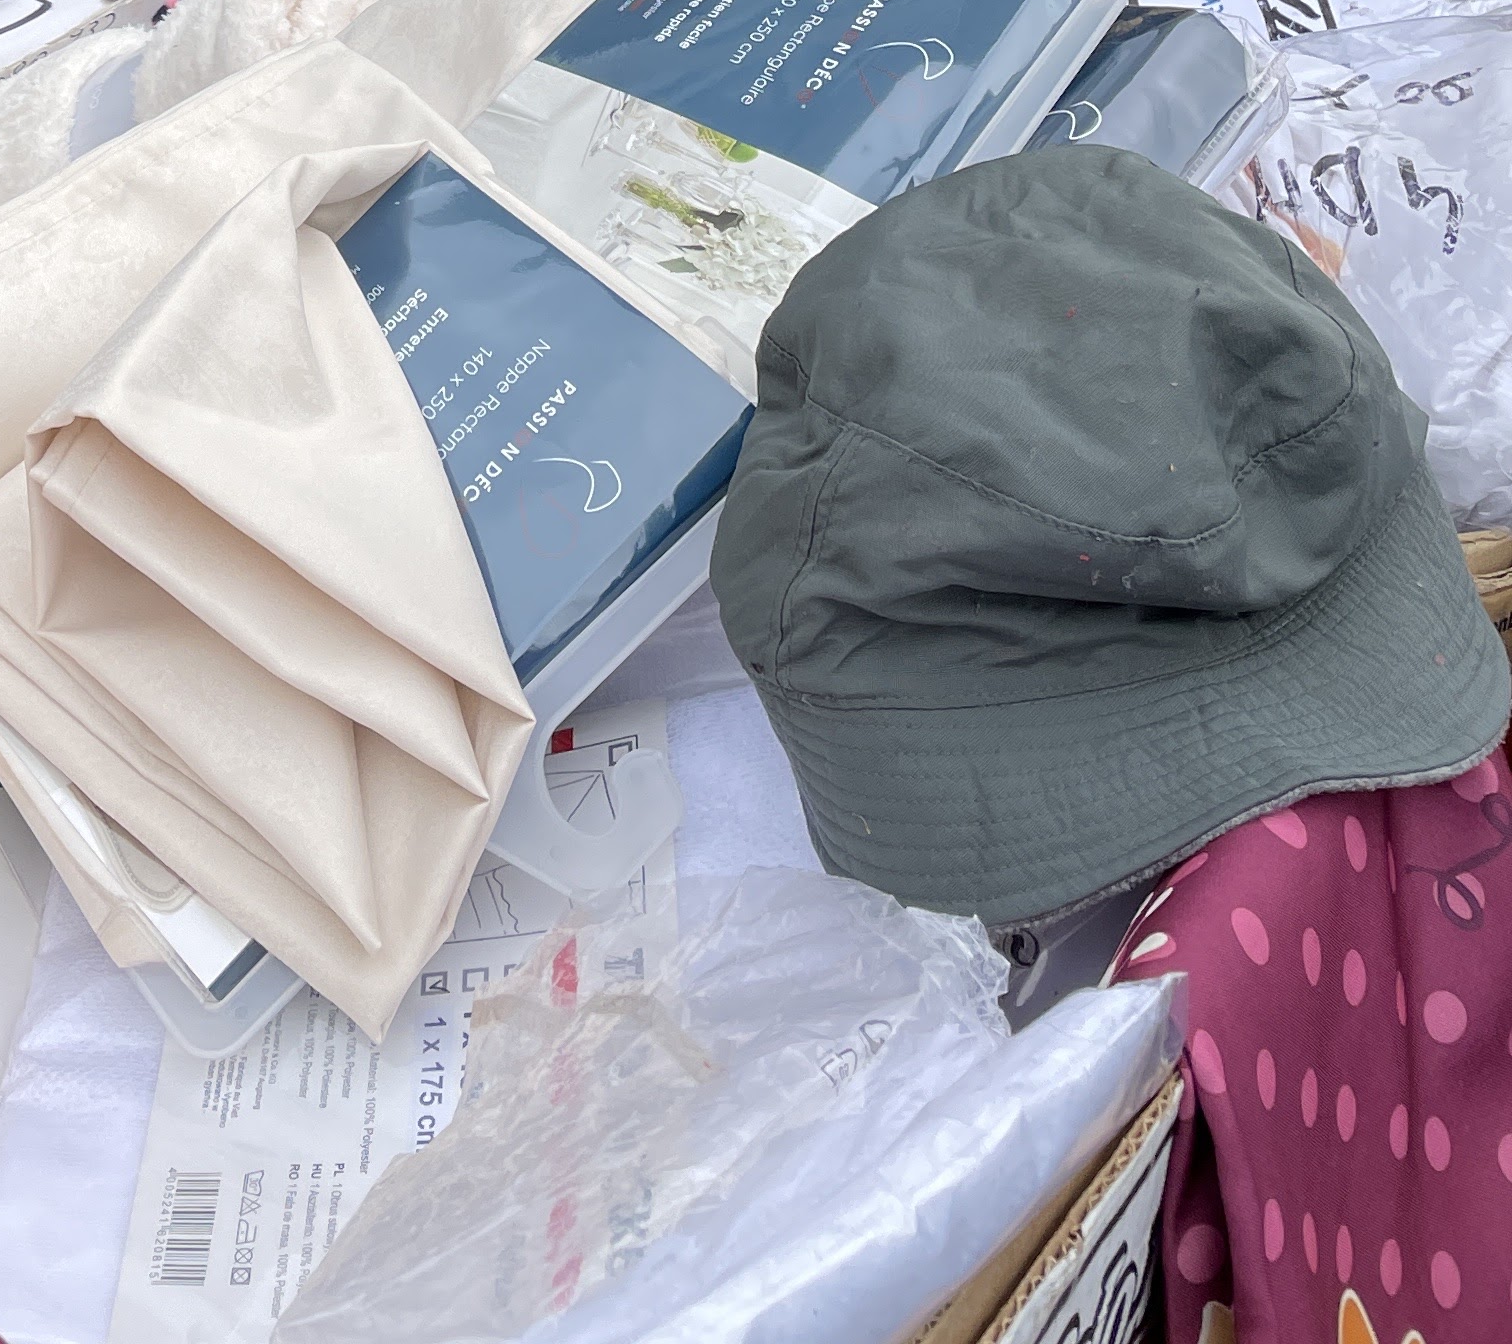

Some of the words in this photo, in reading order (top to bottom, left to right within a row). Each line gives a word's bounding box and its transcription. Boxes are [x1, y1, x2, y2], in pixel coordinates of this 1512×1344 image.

[654, 4, 692, 43] rapide
[678, 17, 714, 50] facile
[749, 16, 778, 43] 250
[729, 42, 754, 66] cm
[739, 13, 822, 108] Rectangulaire
[379, 288, 428, 338] Sécha
[394, 307, 449, 363] Entretie
[462, 345, 494, 376] 140
[496, 338, 552, 394] Nappe
[420, 386, 455, 420] 250
[439, 393, 500, 462] Rectan
[462, 460, 504, 503] DÉC
[424, 1017, 445, 1028] 1
[303, 1038, 315, 1059] 100%
[323, 1045, 334, 1067] 100%
[345, 1037, 356, 1059] 100%
[423, 1039, 441, 1054] x
[299, 1062, 314, 1098] Polyester
[341, 1062, 355, 1098] Polyester
[366, 1053, 380, 1093] Material:
[419, 1062, 446, 1106] 175
[363, 1097, 376, 1125] 100%
[359, 1128, 374, 1174] Polyester
[288, 1163, 300, 1180] RO
[311, 1163, 322, 1179] HU
[333, 1163, 344, 1177] PL
[300, 1242, 313, 1266] 100%
